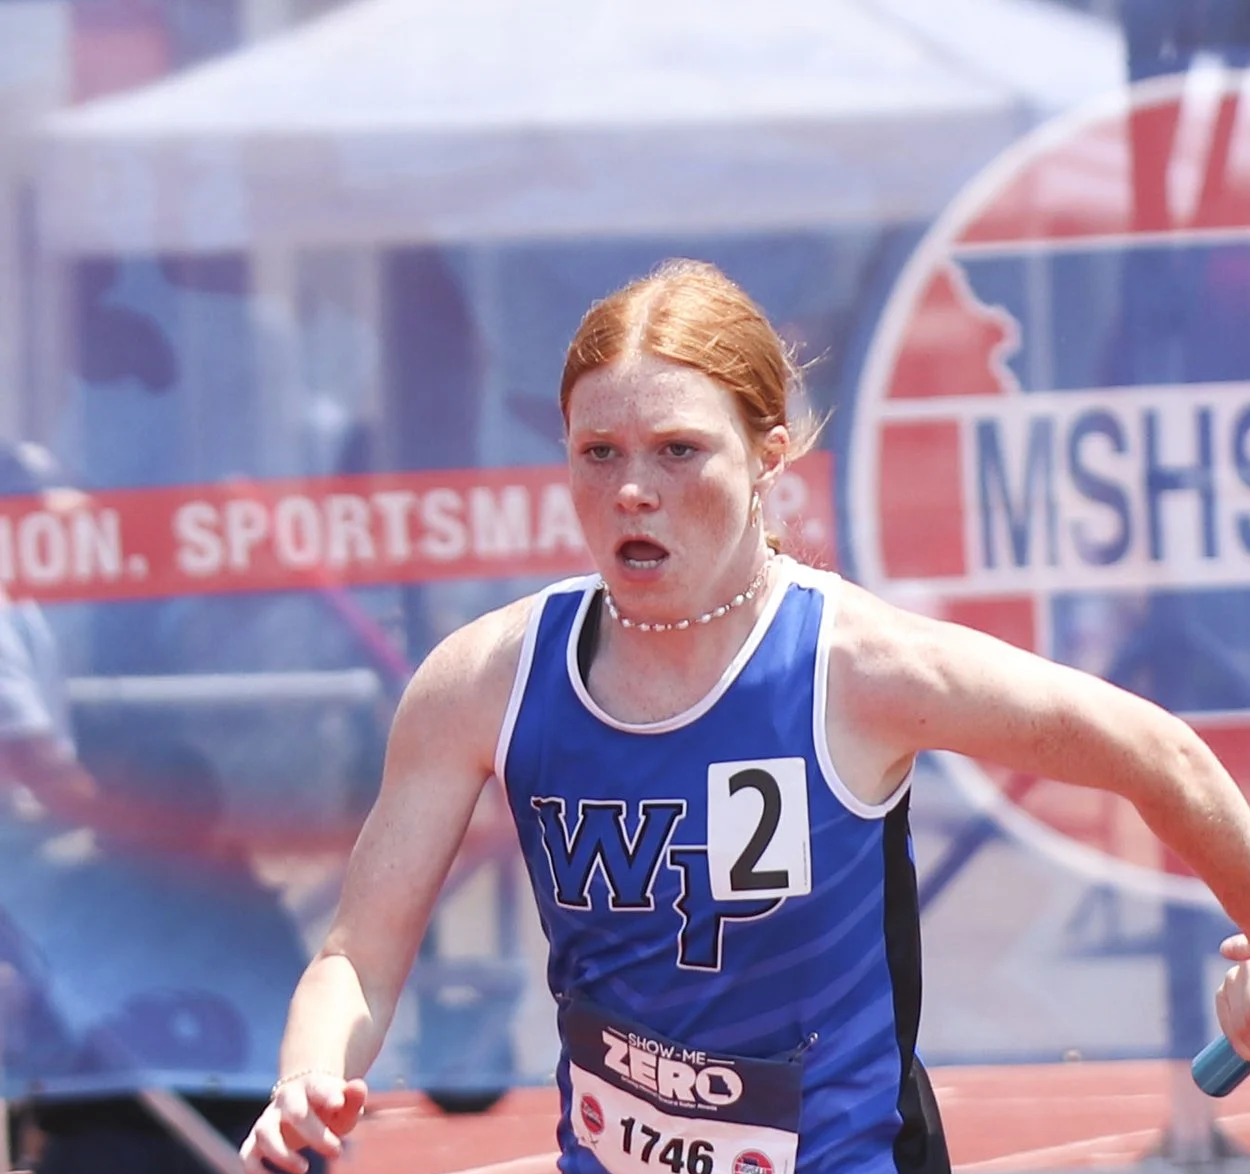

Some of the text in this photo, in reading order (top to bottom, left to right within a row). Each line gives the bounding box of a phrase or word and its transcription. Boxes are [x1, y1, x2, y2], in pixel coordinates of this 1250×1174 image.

[728, 768, 789, 891] 2
[602, 1030, 743, 1106] ZERO
[628, 1032, 707, 1066] SHOW-ME
